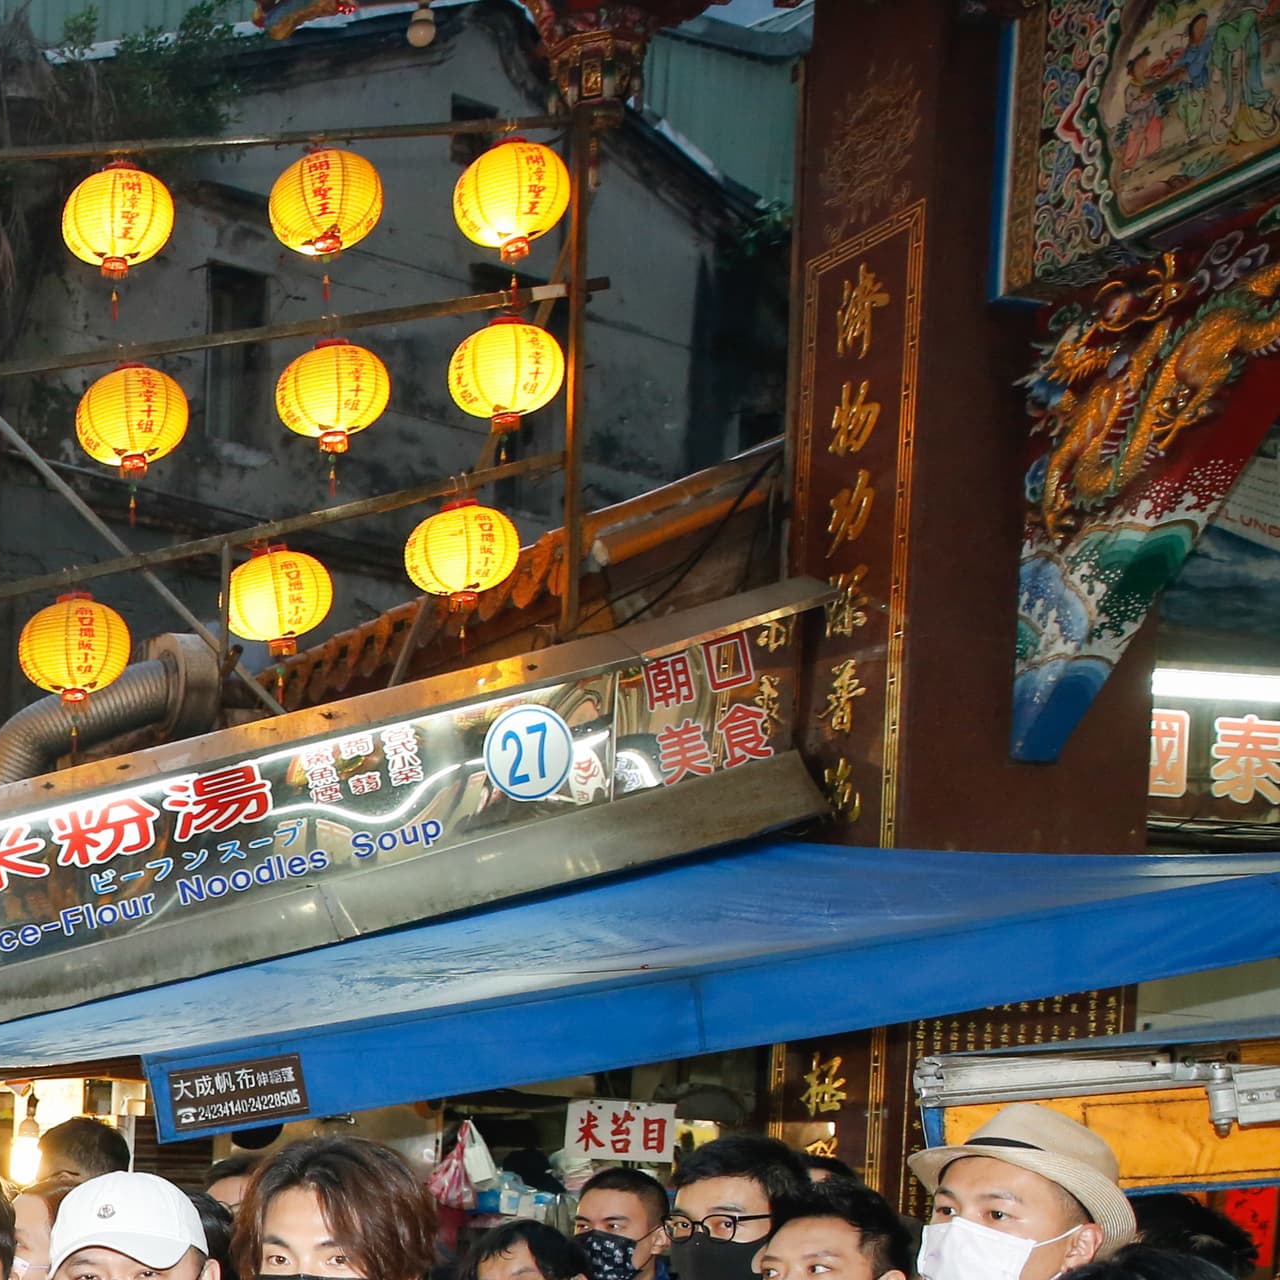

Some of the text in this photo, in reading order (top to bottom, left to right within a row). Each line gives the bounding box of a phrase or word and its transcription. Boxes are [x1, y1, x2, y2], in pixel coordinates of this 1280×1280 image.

[642, 632, 756, 713] 廟口
[500, 721, 548, 788] 27
[656, 703, 775, 788] 美食
[89, 818, 304, 896] ビーフンスープ
[179, 844, 329, 905] Noodles
[349, 816, 443, 861] Soup
[574, 1109, 668, 1155] 米苔目
